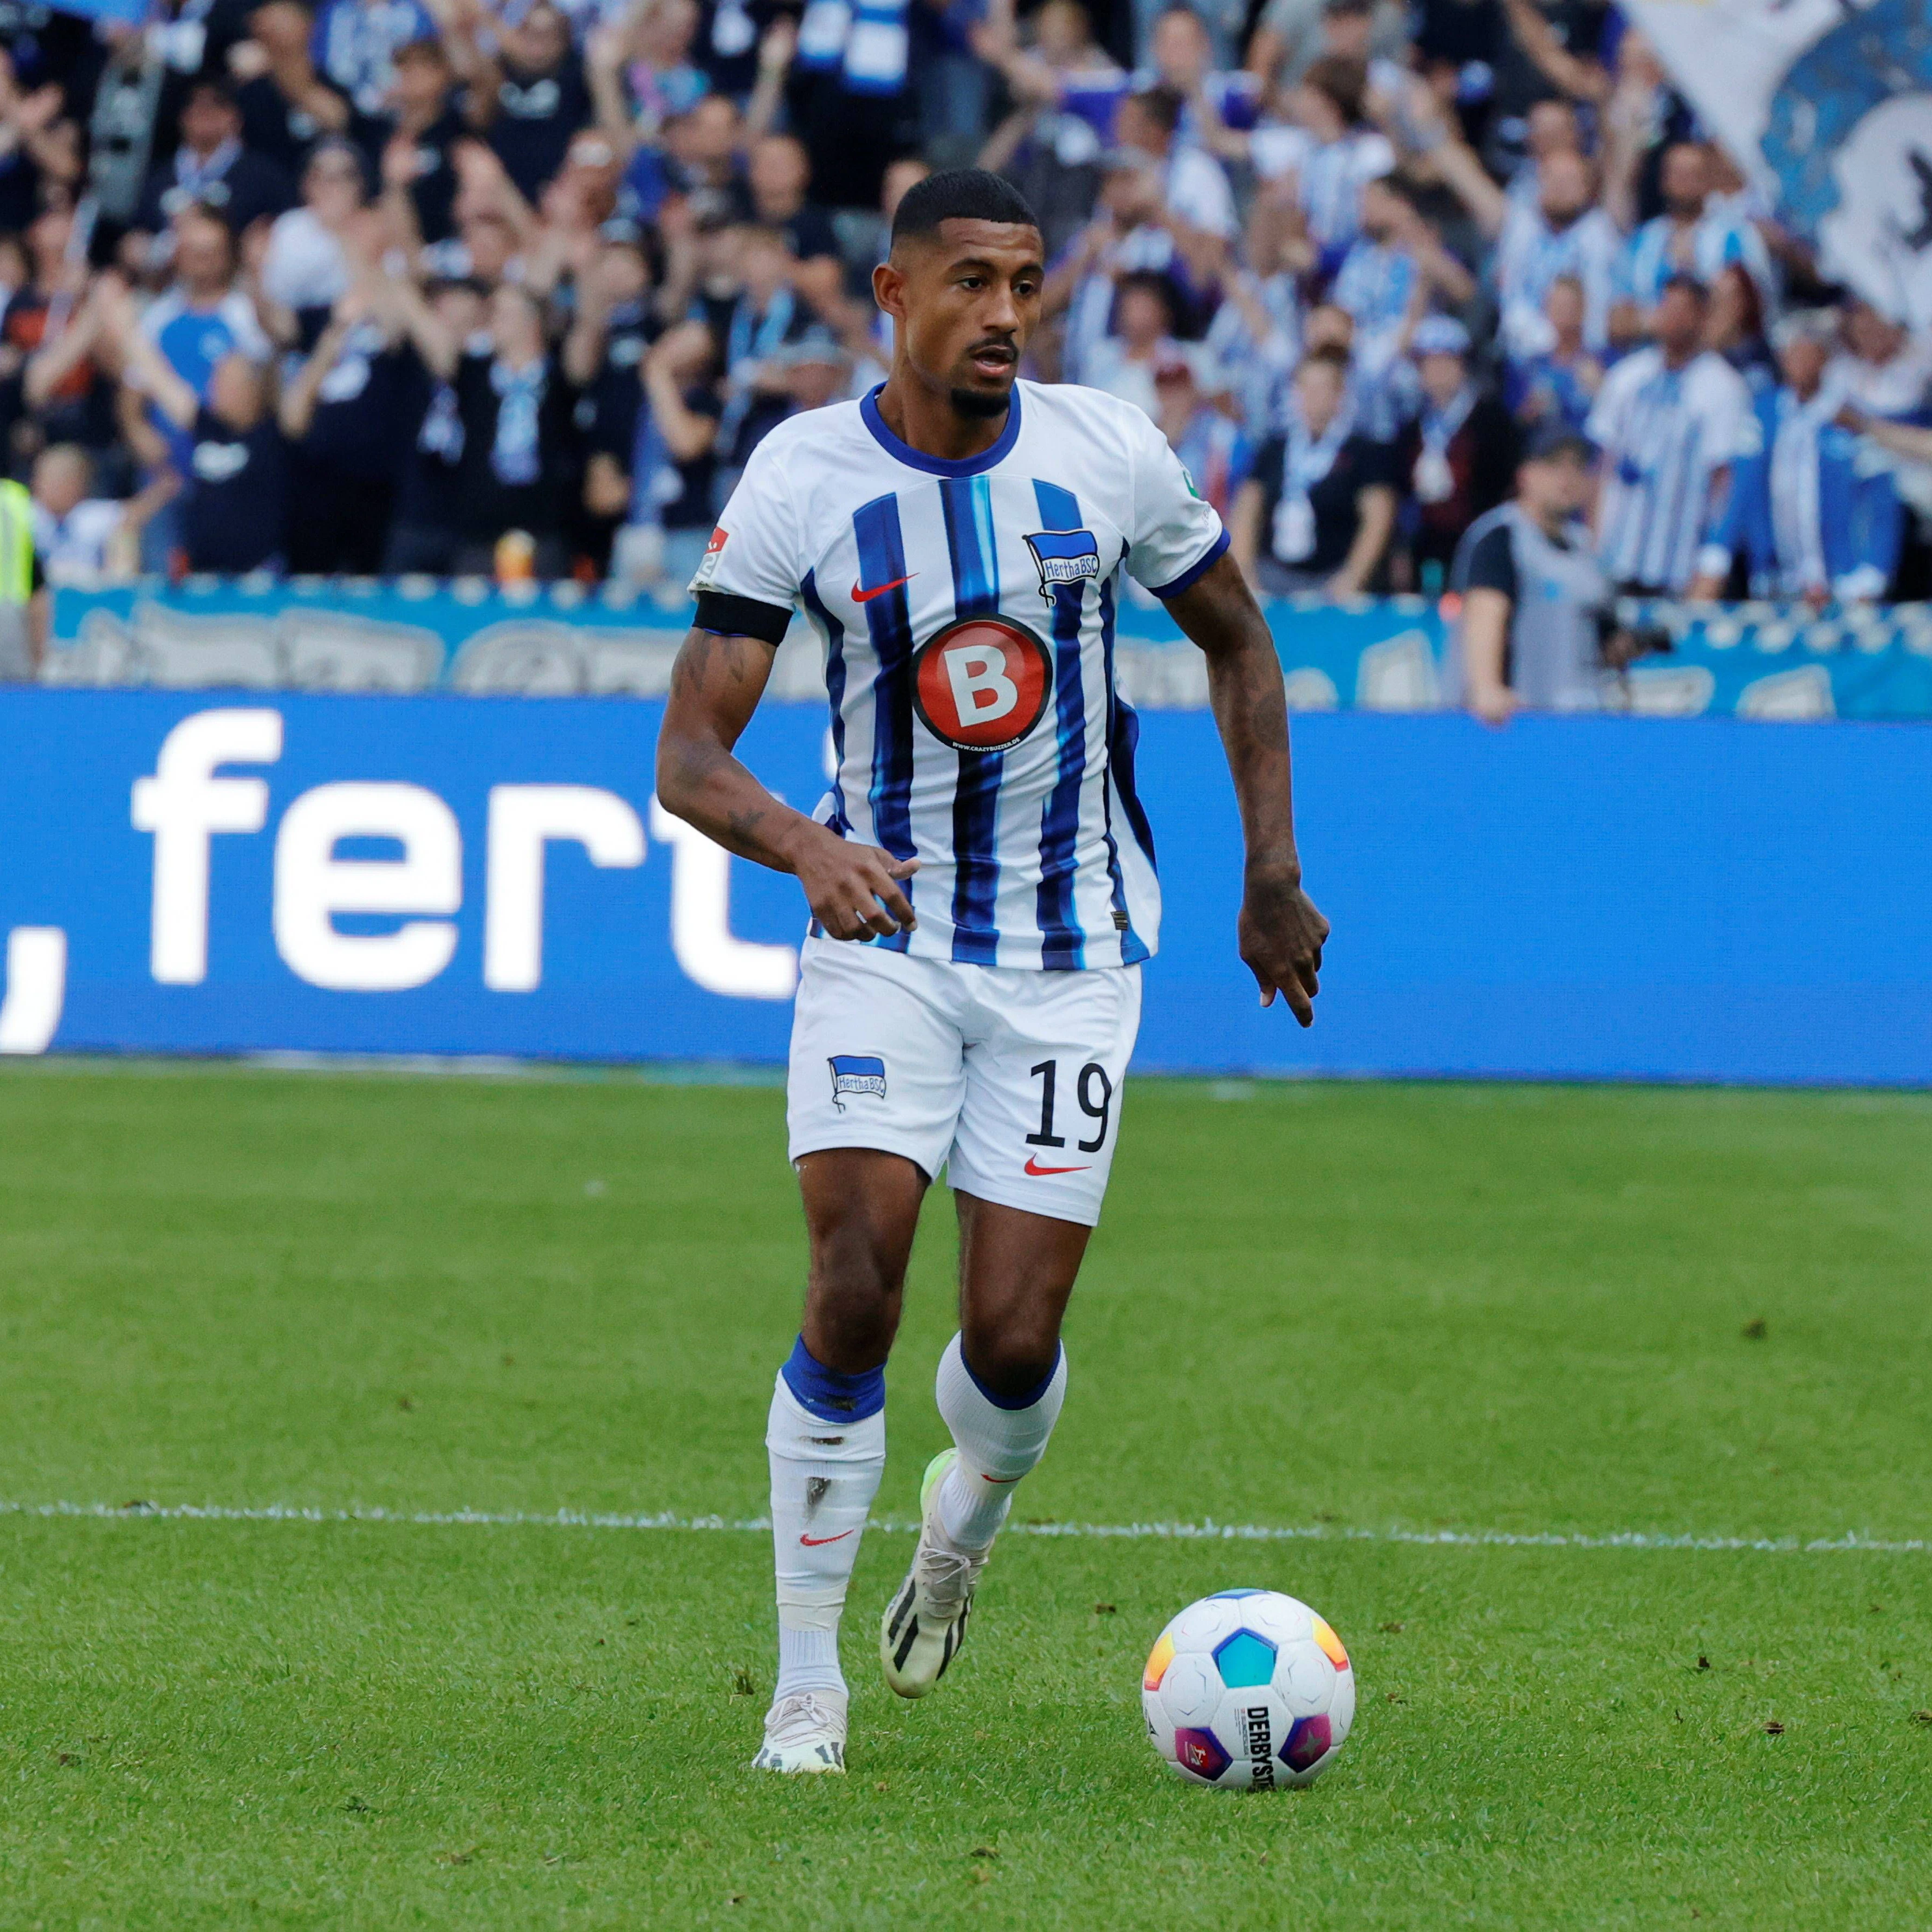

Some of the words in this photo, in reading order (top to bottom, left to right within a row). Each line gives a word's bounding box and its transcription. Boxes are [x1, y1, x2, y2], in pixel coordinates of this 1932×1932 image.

[944, 645, 1018, 728] B
[952, 737, 1021, 752] WWW.CRAZYBUZZER.DE
[130, 707, 839, 1000] fert
[1025, 1059, 1112, 1153] 19
[1247, 1706, 1274, 1787] DERBYST
